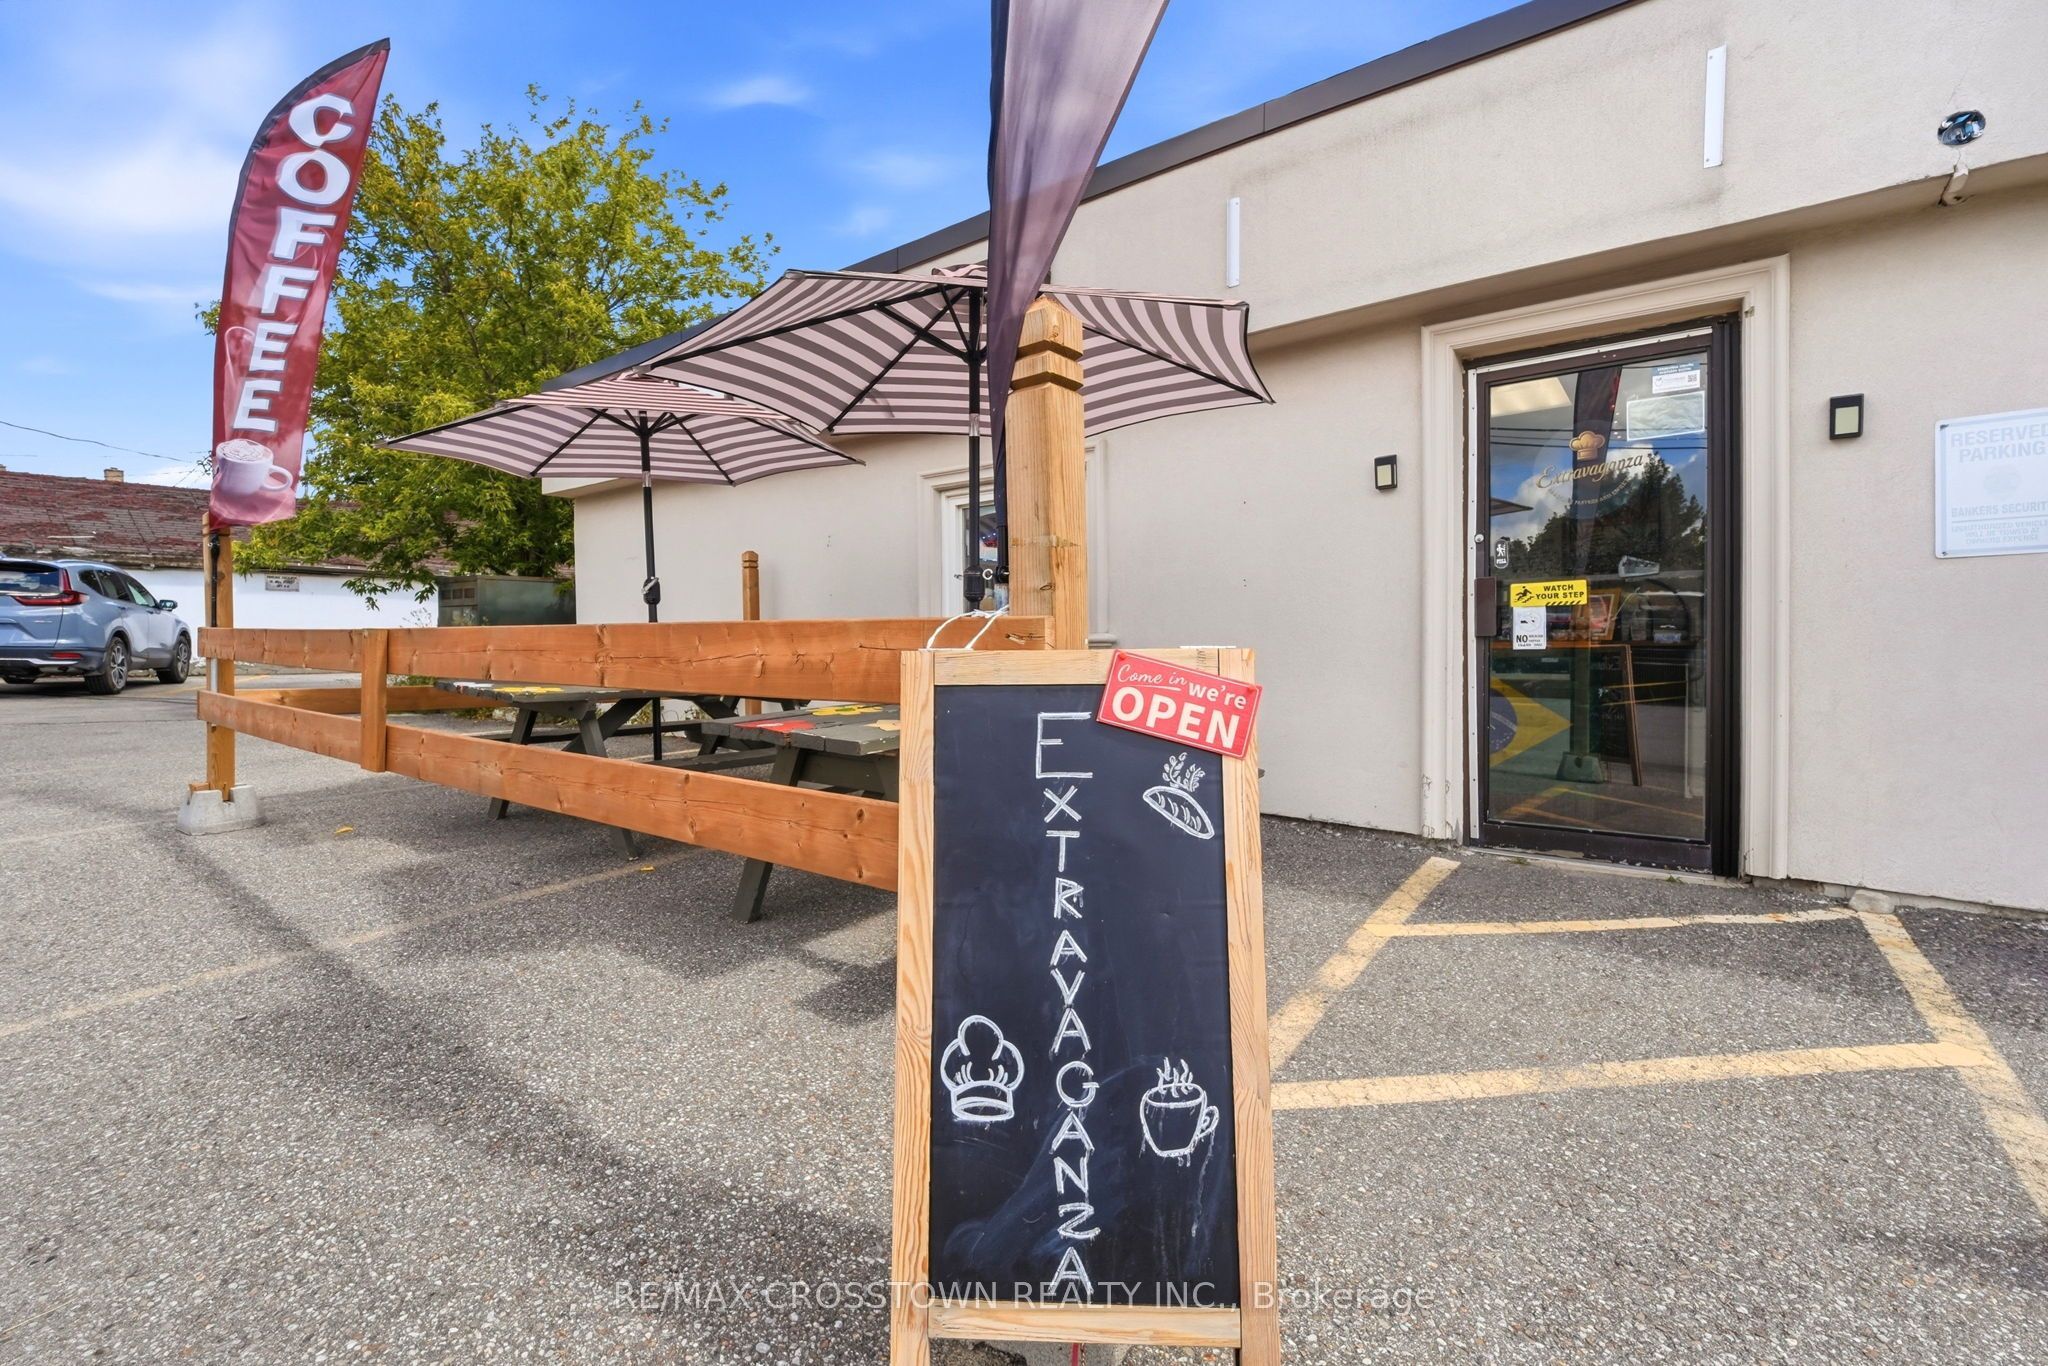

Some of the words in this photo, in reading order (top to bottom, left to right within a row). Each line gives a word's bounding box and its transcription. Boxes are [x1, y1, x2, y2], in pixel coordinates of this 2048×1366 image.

[233, 94, 355, 434] COFFEE
[1960, 441, 2046, 463] PARKING
[1536, 454, 1643, 489] Extravaganza
[2001, 500, 2048, 513] SECURIT
[1543, 584, 1574, 592] WATCH
[1563, 591, 1584, 599] STEP
[1516, 634, 1528, 643] NO
[1117, 664, 1162, 683] Come
[1168, 671, 1187, 685] in
[1112, 687, 1240, 749] OPEN
[1036, 712, 1100, 1296] EXTRAVAGANZA
